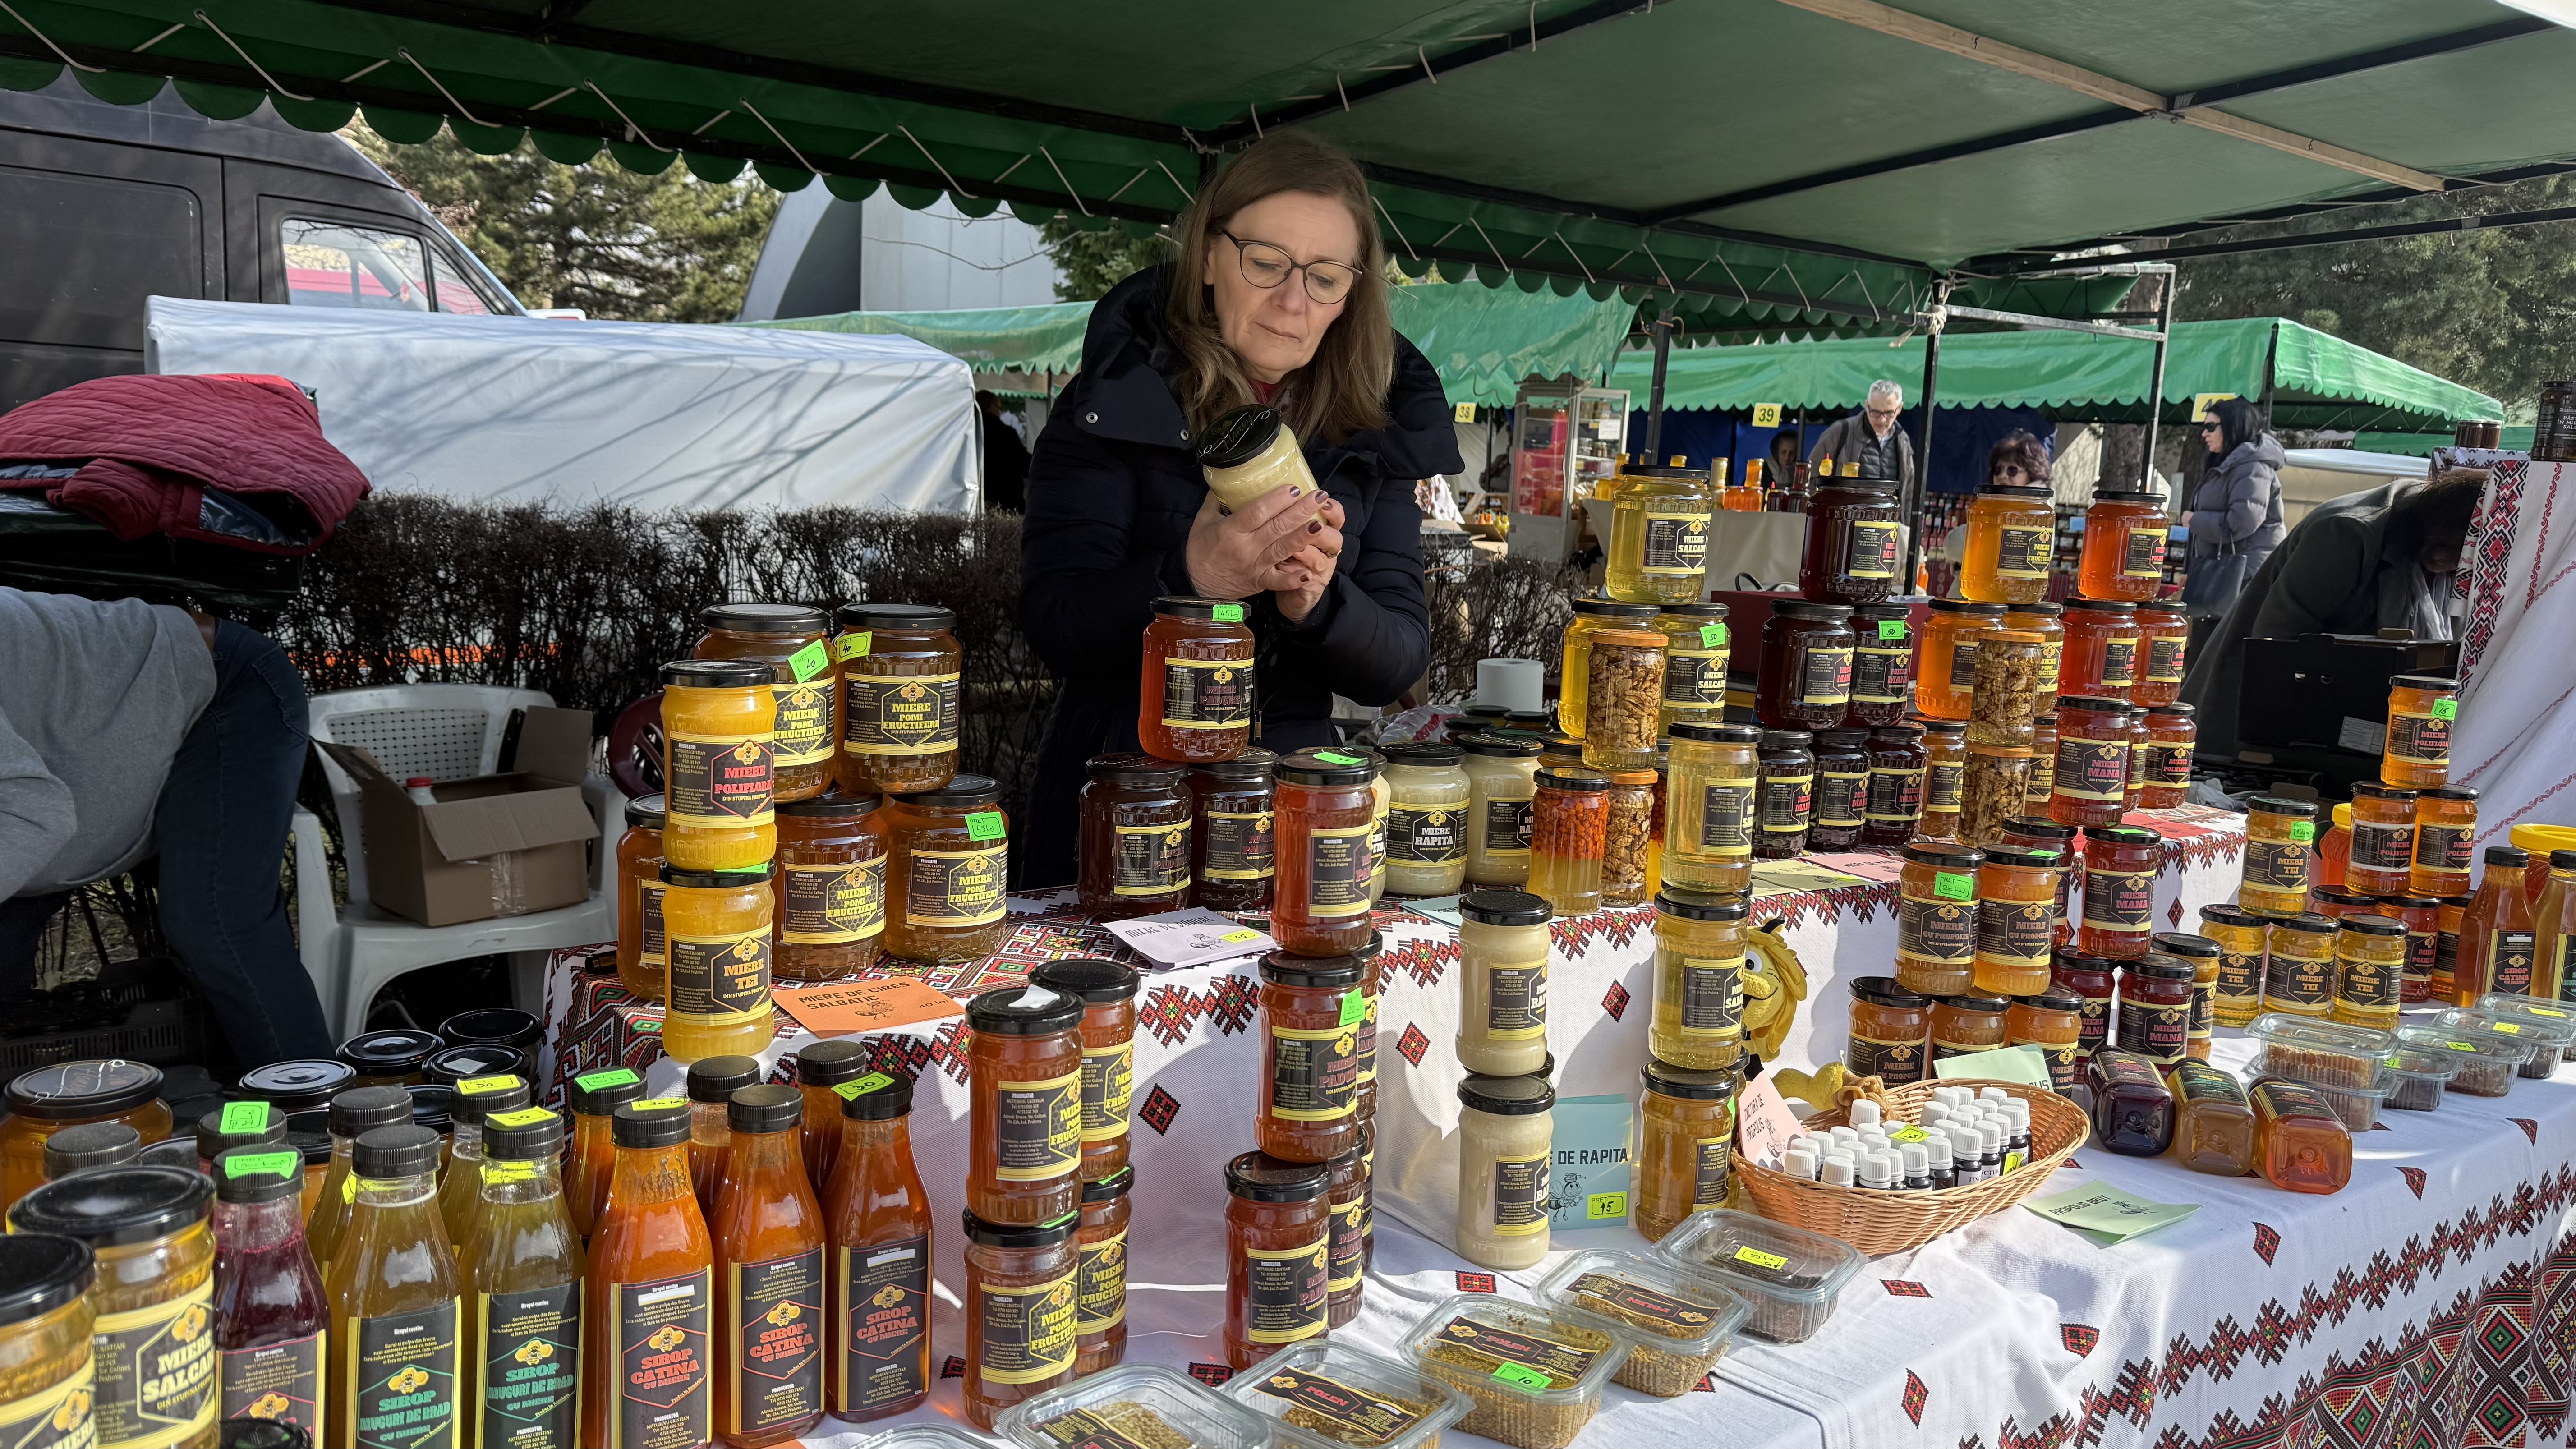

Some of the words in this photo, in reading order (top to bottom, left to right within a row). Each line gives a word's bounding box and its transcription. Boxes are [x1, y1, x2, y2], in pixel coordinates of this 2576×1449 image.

[1459, 407, 1470, 418] 38
[1759, 408, 1774, 422] 39
[842, 643, 851, 653] 40
[806, 659, 815, 670] 40
[892, 702, 931, 713] MIERE
[1200, 695, 1240, 705] PADURE
[783, 708, 820, 721] MIERE
[775, 725, 825, 739] FRUCTIFERI
[791, 720, 814, 730] POMI
[883, 720, 938, 730] FRUCTIFERI
[724, 765, 766, 778] MIERE
[2088, 768, 2120, 778] MANA
[714, 780, 772, 794] POLIFLORA
[1415, 836, 1454, 846] RAPITA
[959, 873, 993, 886] MIERE
[837, 885, 872, 900] MIERE
[950, 889, 998, 902] FRUCTIFERI
[965, 885, 986, 893] POMI
[828, 902, 877, 917] FRUCTIFERI
[844, 898, 865, 908] POMI
[2116, 900, 2148, 909] MANA
[1125, 926, 1160, 938] MIERE
[1930, 921, 1964, 930] MIERE
[2016, 922, 2046, 930] MIERE
[724, 958, 764, 977] MIERE
[735, 974, 759, 990] TEI
[2227, 975, 2244, 983] TEI
[2295, 974, 2323, 983] MIERE
[2350, 974, 2380, 984] MIERE
[797, 992, 843, 1003] MIERE
[867, 982, 911, 993] CIRES
[2302, 983, 2318, 991] TEI
[2356, 983, 2374, 993] TEI
[807, 995, 879, 1010] SALBATIC
[2149, 1033, 2182, 1042] MANA
[1883, 1062, 1915, 1071] MIERE
[852, 1082, 875, 1090] 30
[1558, 1150, 1575, 1165] DE
[1580, 1148, 1628, 1164] RAPITA
[2048, 1201, 2092, 1215] PROPOLIS
[2085, 1195, 2111, 1205] BRUT
[1092, 1260, 1124, 1283] MIERE
[1099, 1276, 1120, 1292] POMI
[866, 1306, 912, 1325] SIROP
[1041, 1299, 1075, 1327] MIERE
[759, 1323, 808, 1343] SIROP
[856, 1316, 918, 1339] CATINA
[1049, 1317, 1071, 1334] POMI
[867, 1335, 879, 1344] CU
[879, 1329, 908, 1340] MIERE
[1486, 1335, 1532, 1352] POLEN
[158, 1329, 212, 1375] MIERE
[750, 1333, 814, 1358] CATINA
[641, 1348, 693, 1370] SIROP
[761, 1354, 774, 1363] CU
[775, 1346, 805, 1360] MIERE
[506, 1362, 560, 1382] SIROP
[631, 1359, 700, 1385] CATINA
[488, 1383, 530, 1400] MUGURI
[532, 1380, 547, 1394] DE
[547, 1374, 574, 1391] BRAD
[643, 1381, 657, 1390] CU
[658, 1373, 690, 1388] MIERE
[156, 1400, 171, 1410] DIN
[172, 1388, 198, 1407] STUPINA
[378, 1390, 436, 1412] SIROP
[506, 1401, 520, 1411] CU
[522, 1396, 554, 1408] MIERE
[1305, 1386, 1349, 1406] POLEN
[359, 1412, 405, 1431] MUGURI
[406, 1408, 421, 1423] DE
[423, 1401, 450, 1420] BRAD
[379, 1432, 395, 1442] CU
[396, 1425, 430, 1439] MIERE
